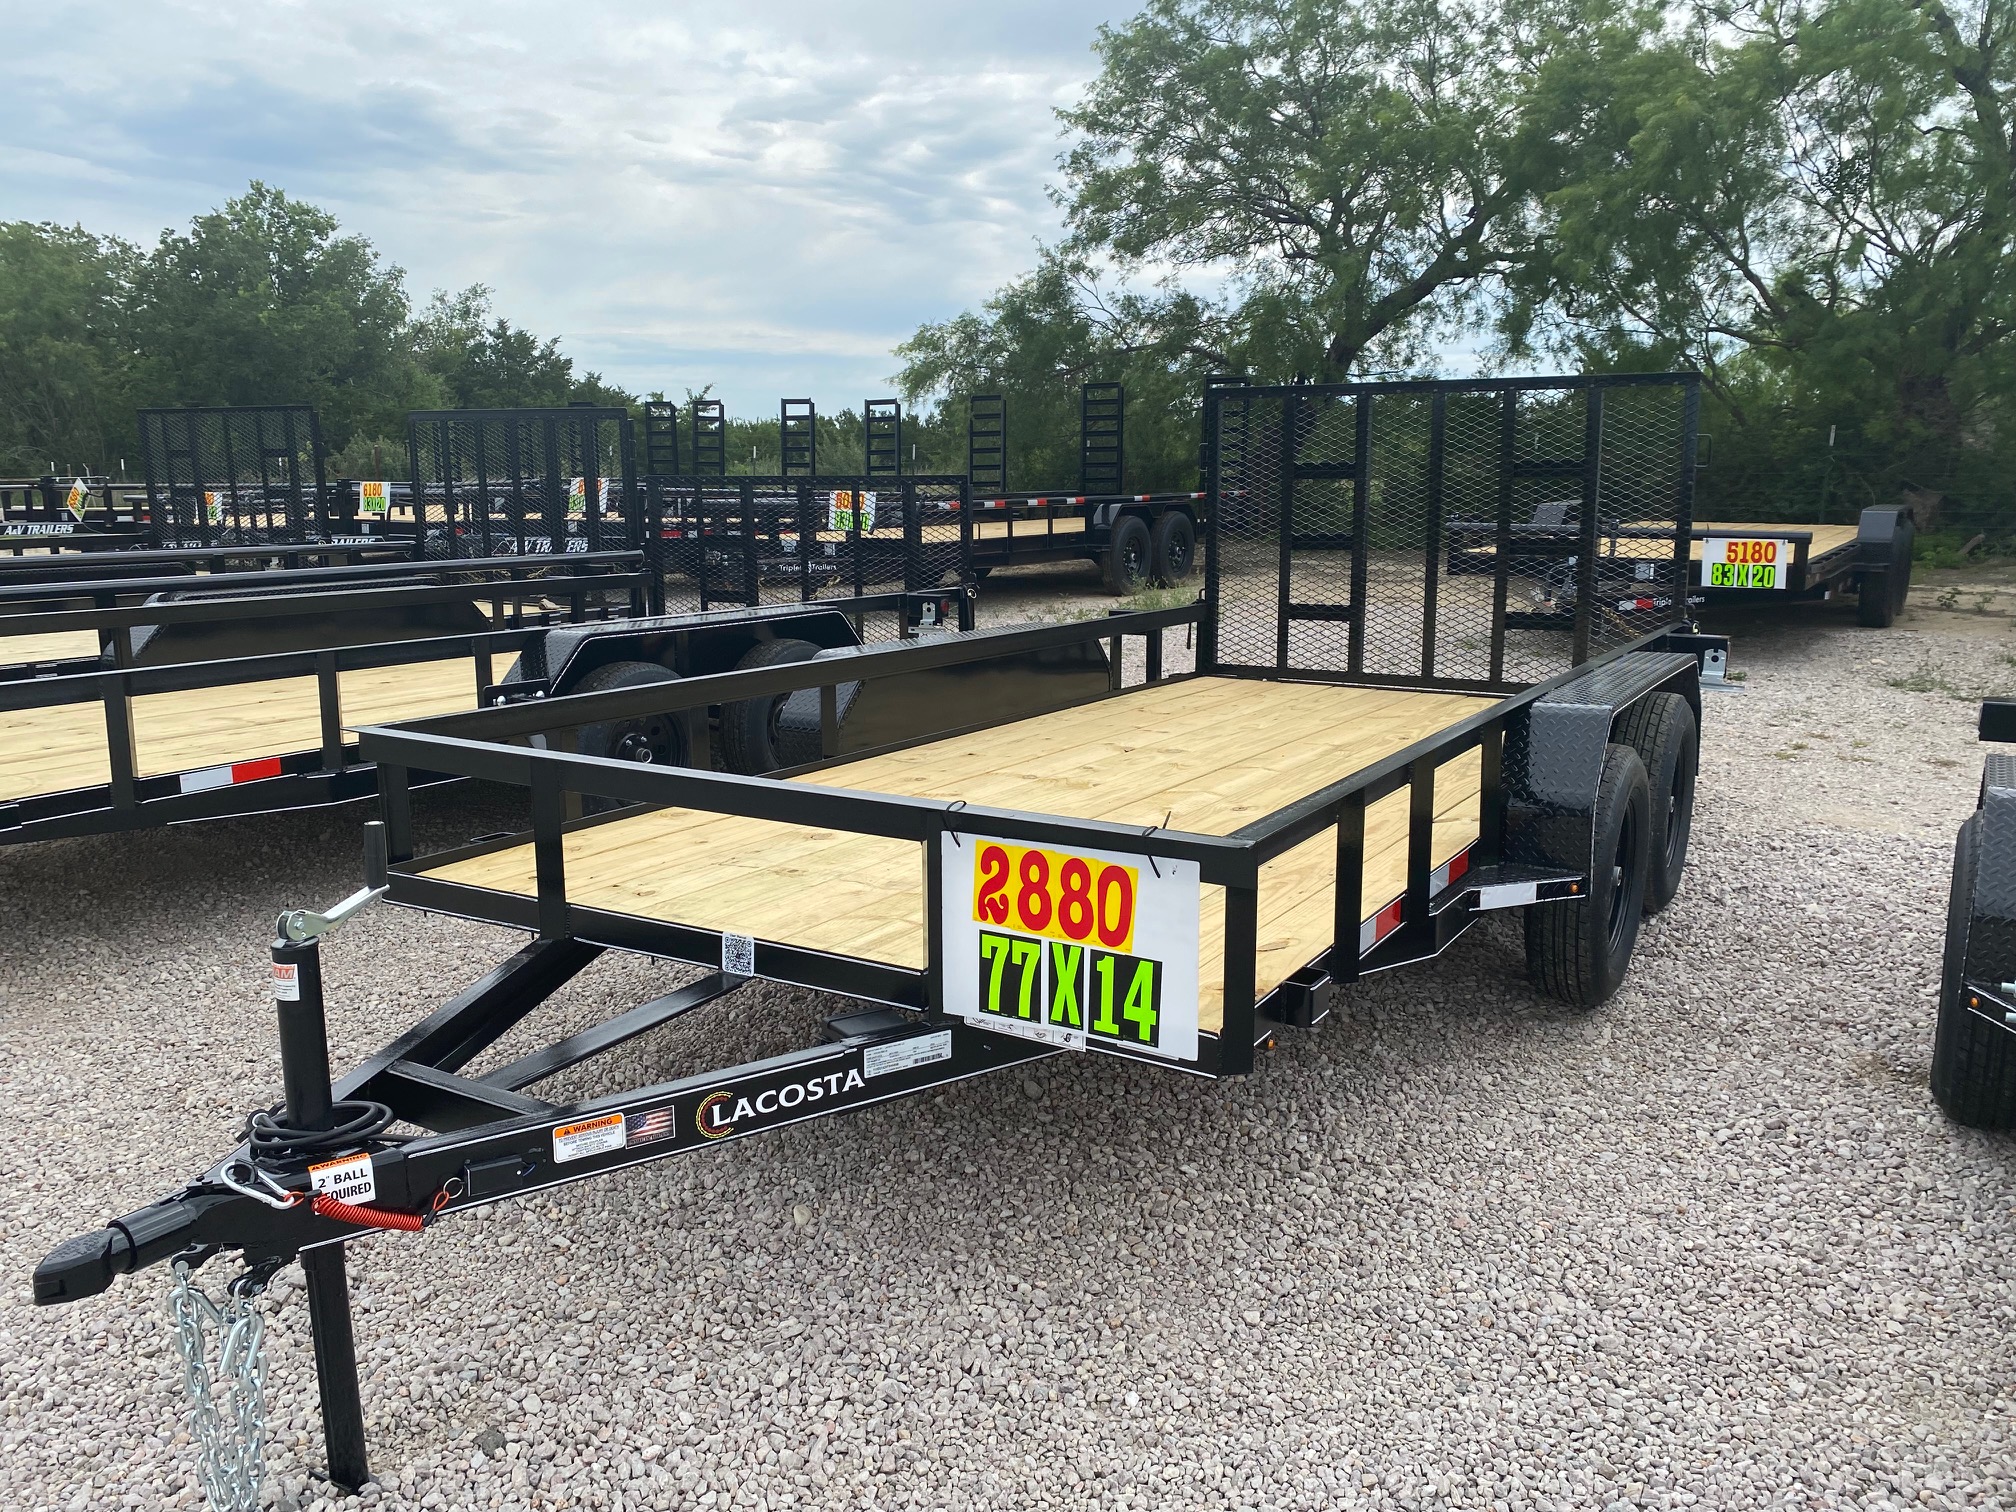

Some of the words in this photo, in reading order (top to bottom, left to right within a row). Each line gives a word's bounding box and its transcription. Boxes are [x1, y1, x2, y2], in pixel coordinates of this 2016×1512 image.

[363, 482, 383, 496] 6180
[4, 525, 25, 535] A&V
[27, 524, 75, 535] TRAILERS
[1727, 541, 1776, 563] 5180
[978, 846, 1133, 948] 2880
[711, 1068, 866, 1128] LACOSTA
[573, 1117, 613, 1134] WARNING
[320, 1154, 367, 1168] WARNING
[334, 1168, 367, 1184] BALL
